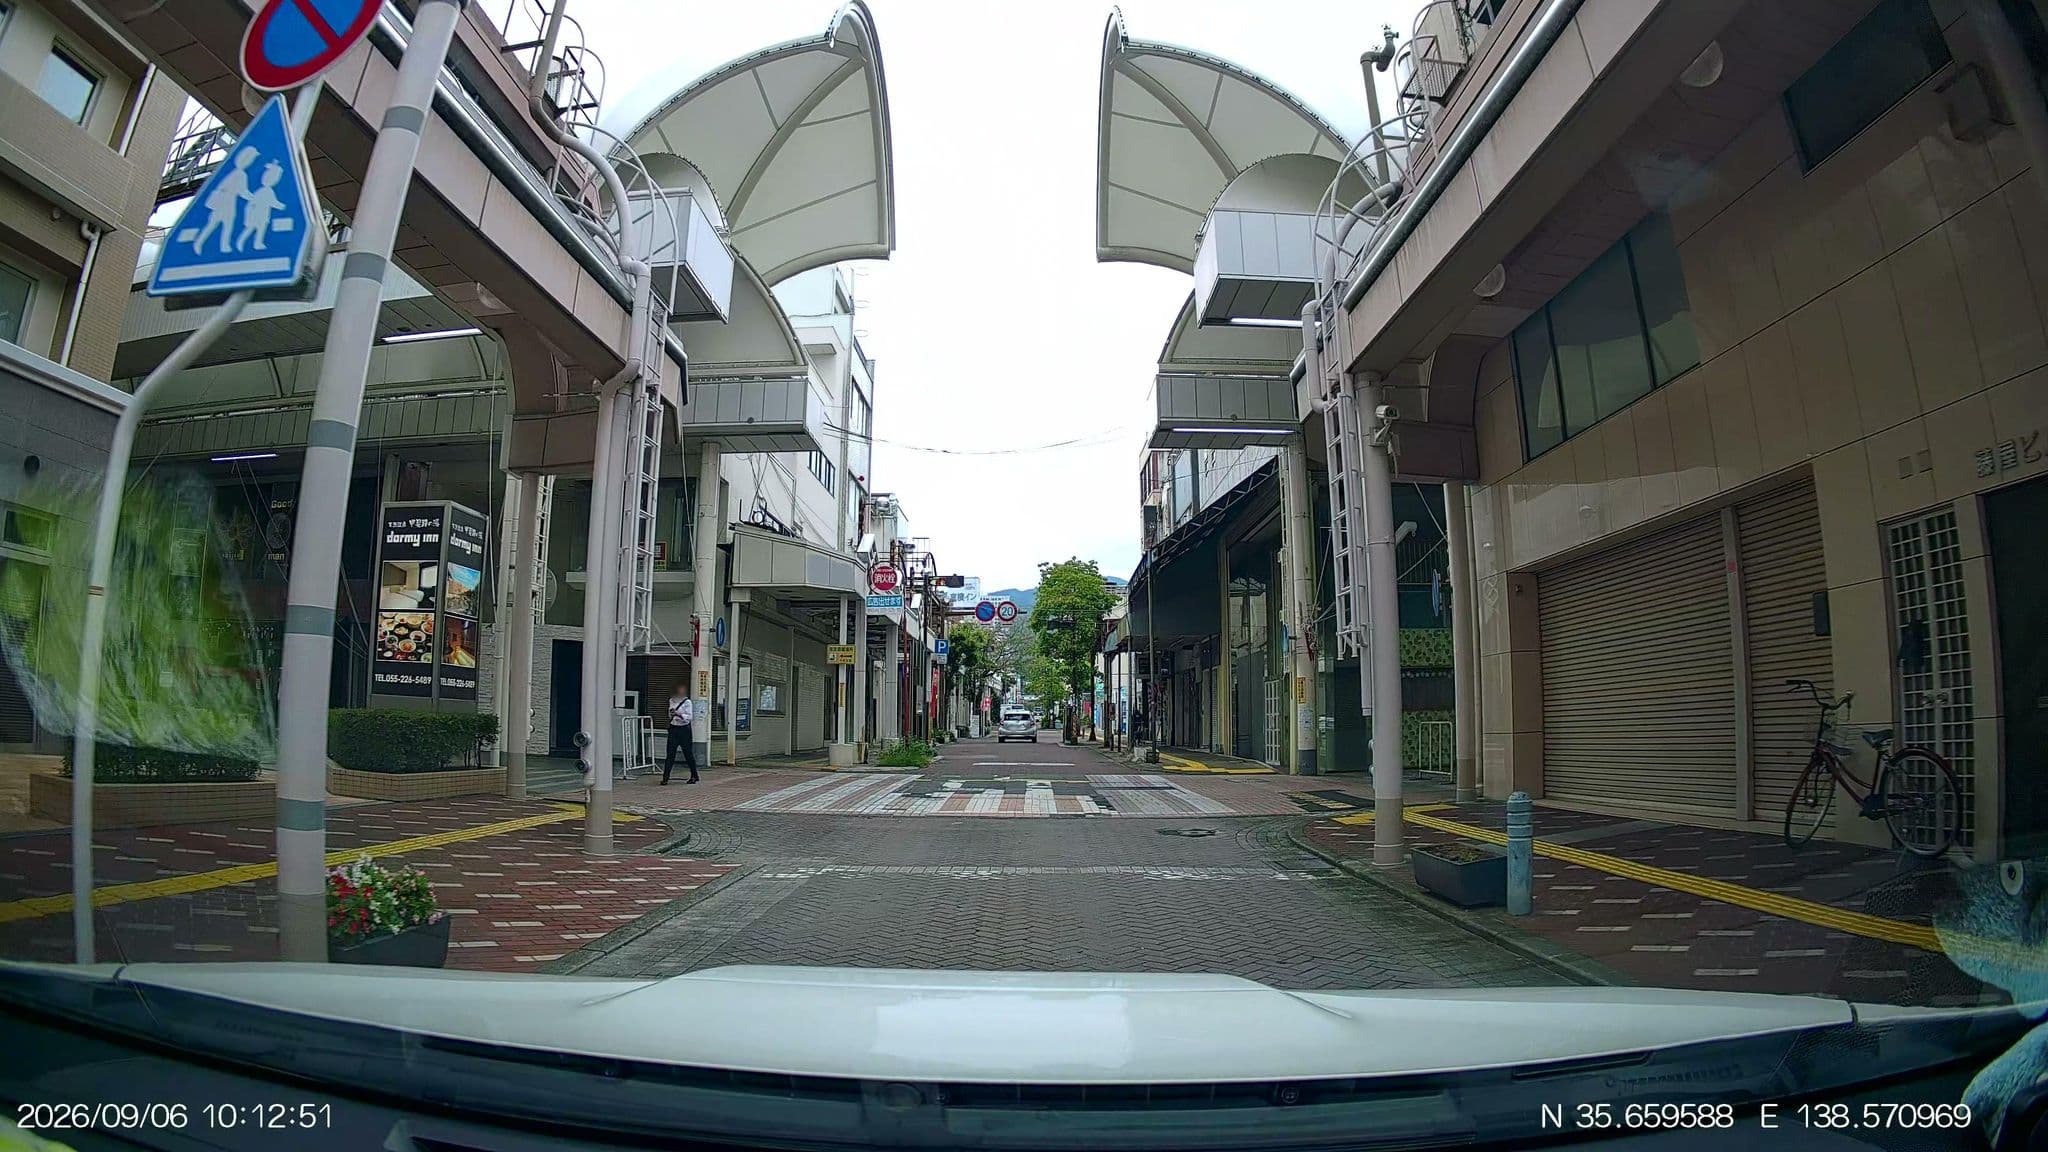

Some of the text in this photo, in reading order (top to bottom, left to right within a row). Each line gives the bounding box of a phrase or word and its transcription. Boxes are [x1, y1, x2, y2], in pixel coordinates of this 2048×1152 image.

[386, 530, 439, 547] dormy inn
[450, 533, 472, 554] dormy
[874, 573, 896, 584] 消火栓
[1001, 606, 1014, 617] 20
[938, 642, 947, 653] P
